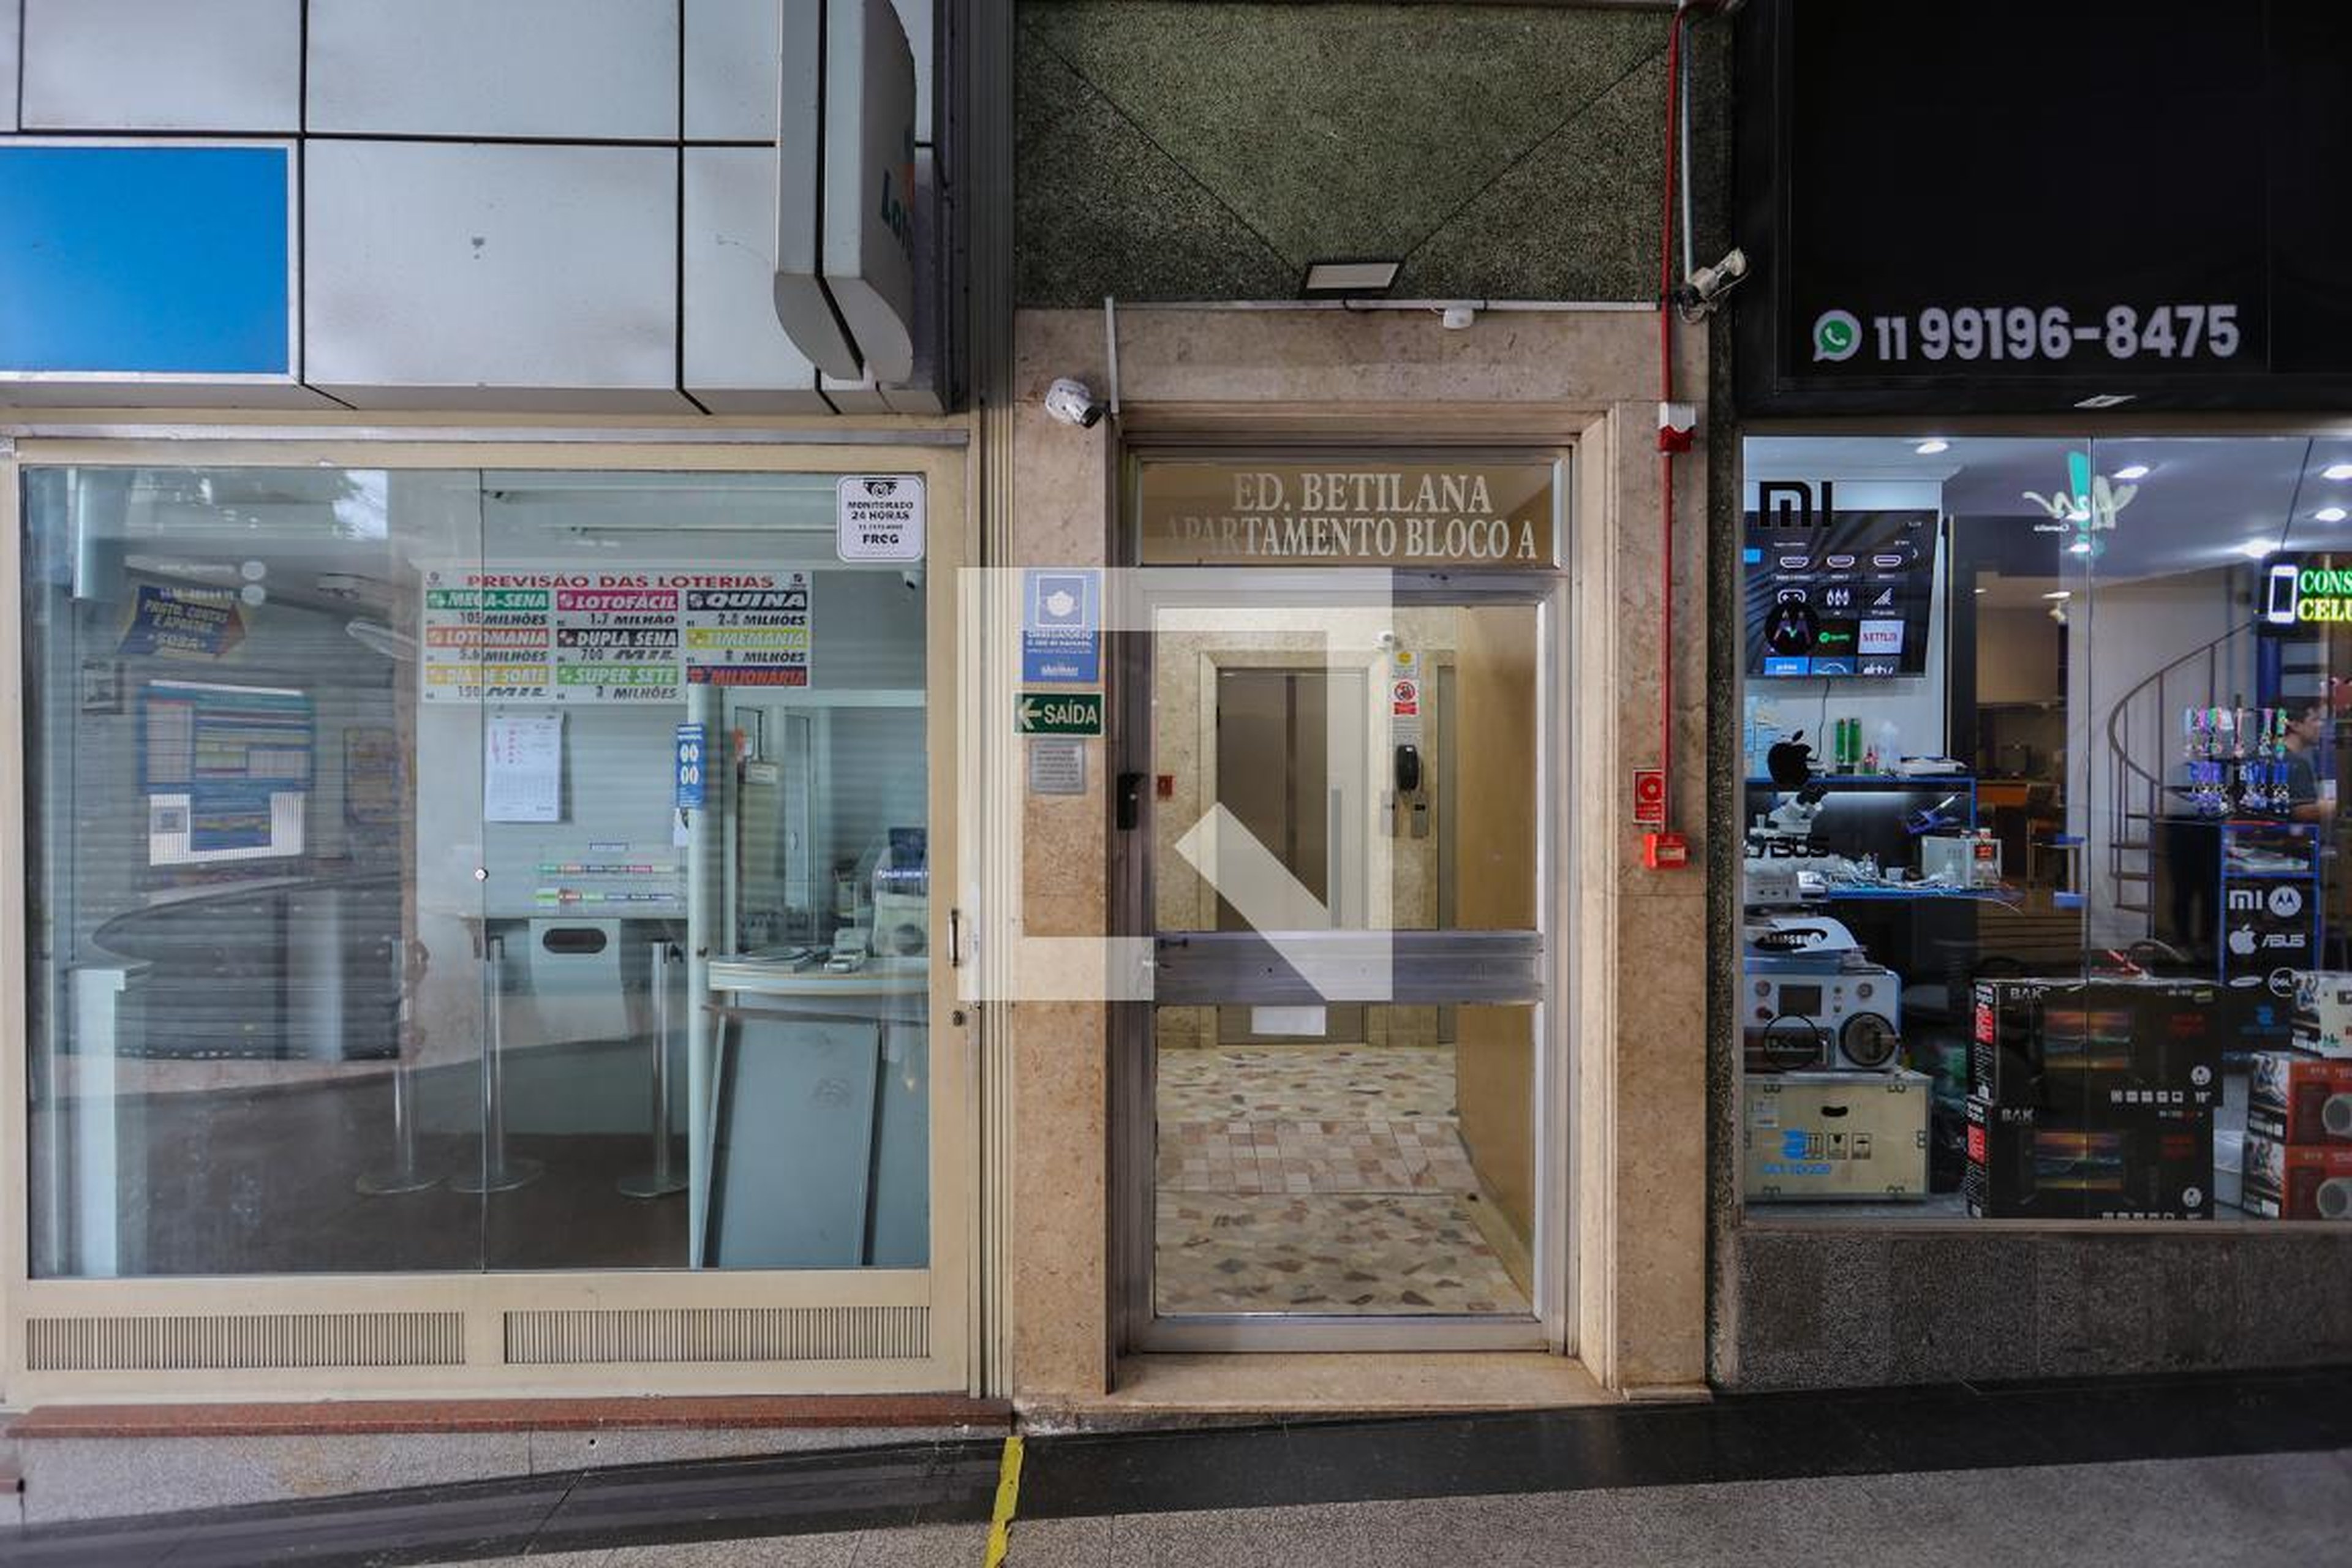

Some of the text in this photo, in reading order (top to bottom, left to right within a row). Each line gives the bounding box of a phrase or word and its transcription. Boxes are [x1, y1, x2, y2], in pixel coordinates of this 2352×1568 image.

[1874, 306, 2240, 360] 11 99196-8475
[1232, 473, 1492, 513] ED. BETILANA
[869, 510, 910, 520] HORAS
[1167, 516, 1537, 559] APARTAMENTO BLOCO A
[467, 573, 775, 589] PREVISÃO DAS LOTERIAS
[447, 590, 547, 608] MEGA-SENA
[706, 593, 805, 608] QUINA
[484, 612, 547, 626] MILHÕES
[743, 613, 805, 626] MILHÕES
[447, 630, 547, 646] LOTOMANIA
[578, 631, 677, 646] DUPLA SENA
[483, 649, 546, 662] MILHÕES
[743, 649, 805, 663] MILHÕES
[574, 668, 630, 684] SUPER
[614, 687, 677, 699] MILHÕES
[1044, 699, 1098, 725] SAÍDA
[2261, 933, 2306, 948] ASUS
[2010, 987, 2041, 999] BAK
[2002, 1109, 2034, 1122] BAK
